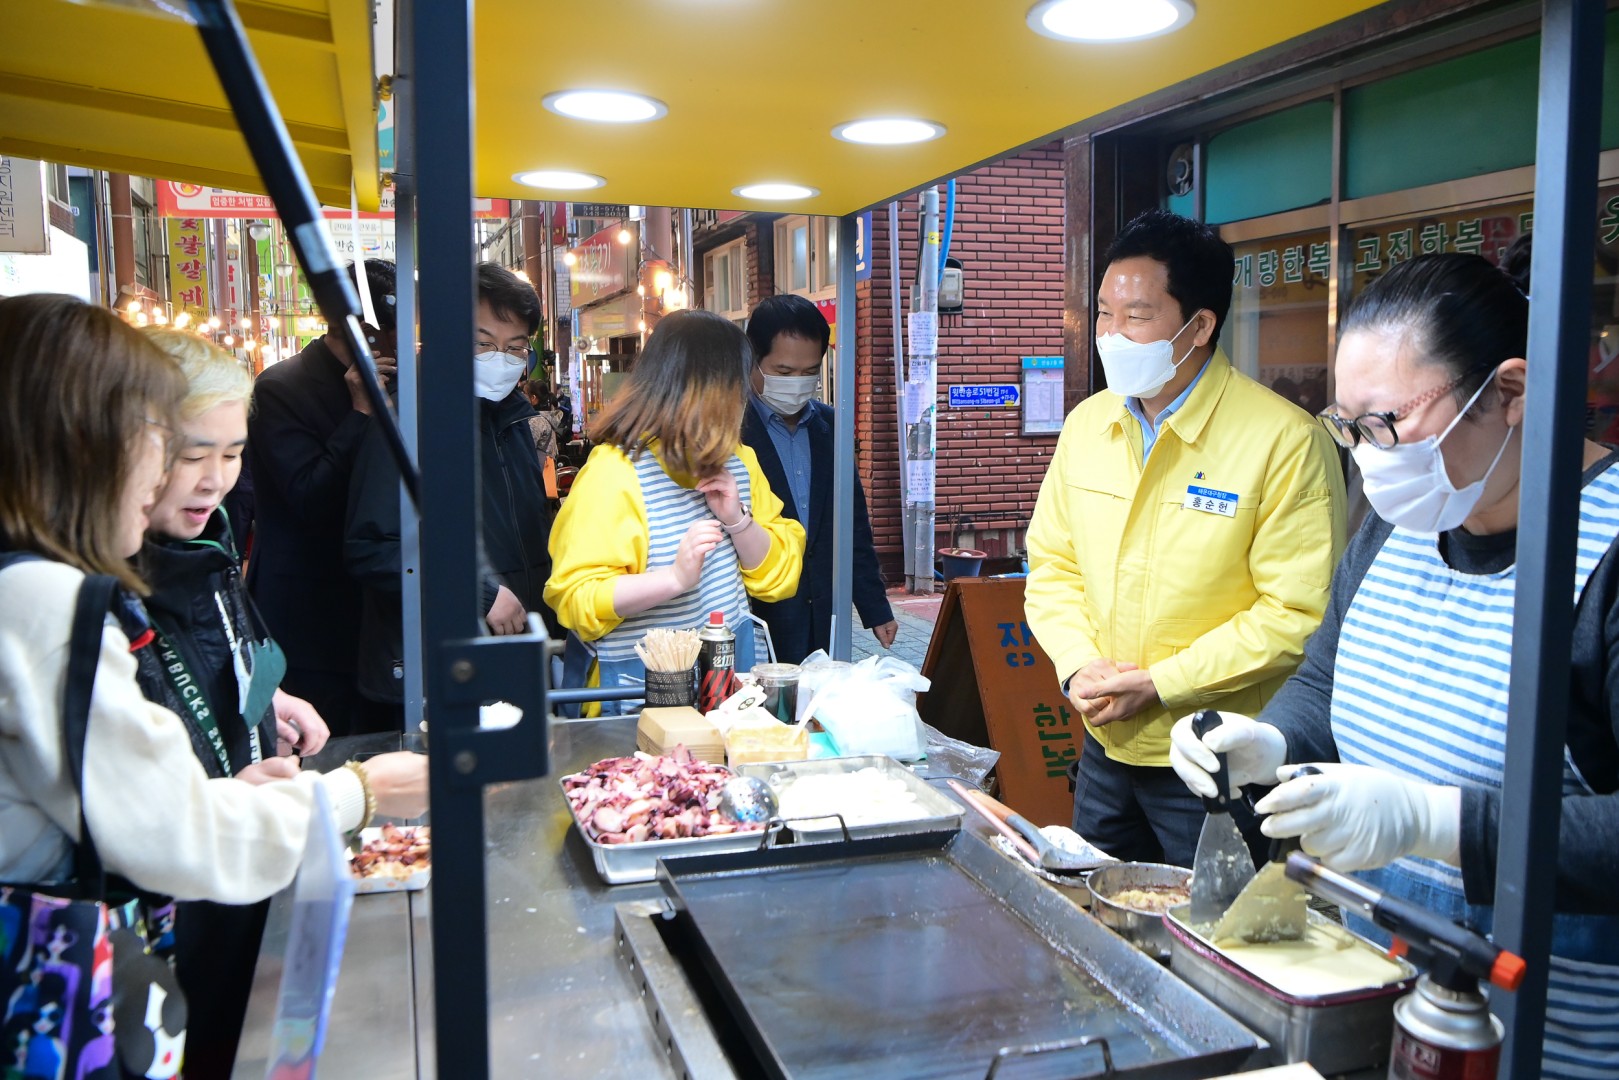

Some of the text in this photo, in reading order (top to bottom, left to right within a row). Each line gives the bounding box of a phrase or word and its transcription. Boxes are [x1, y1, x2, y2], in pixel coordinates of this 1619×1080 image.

[212, 196, 236, 207] 엄중한
[238, 196, 254, 207] 처벌
[1233, 242, 1331, 288] 개량한복
